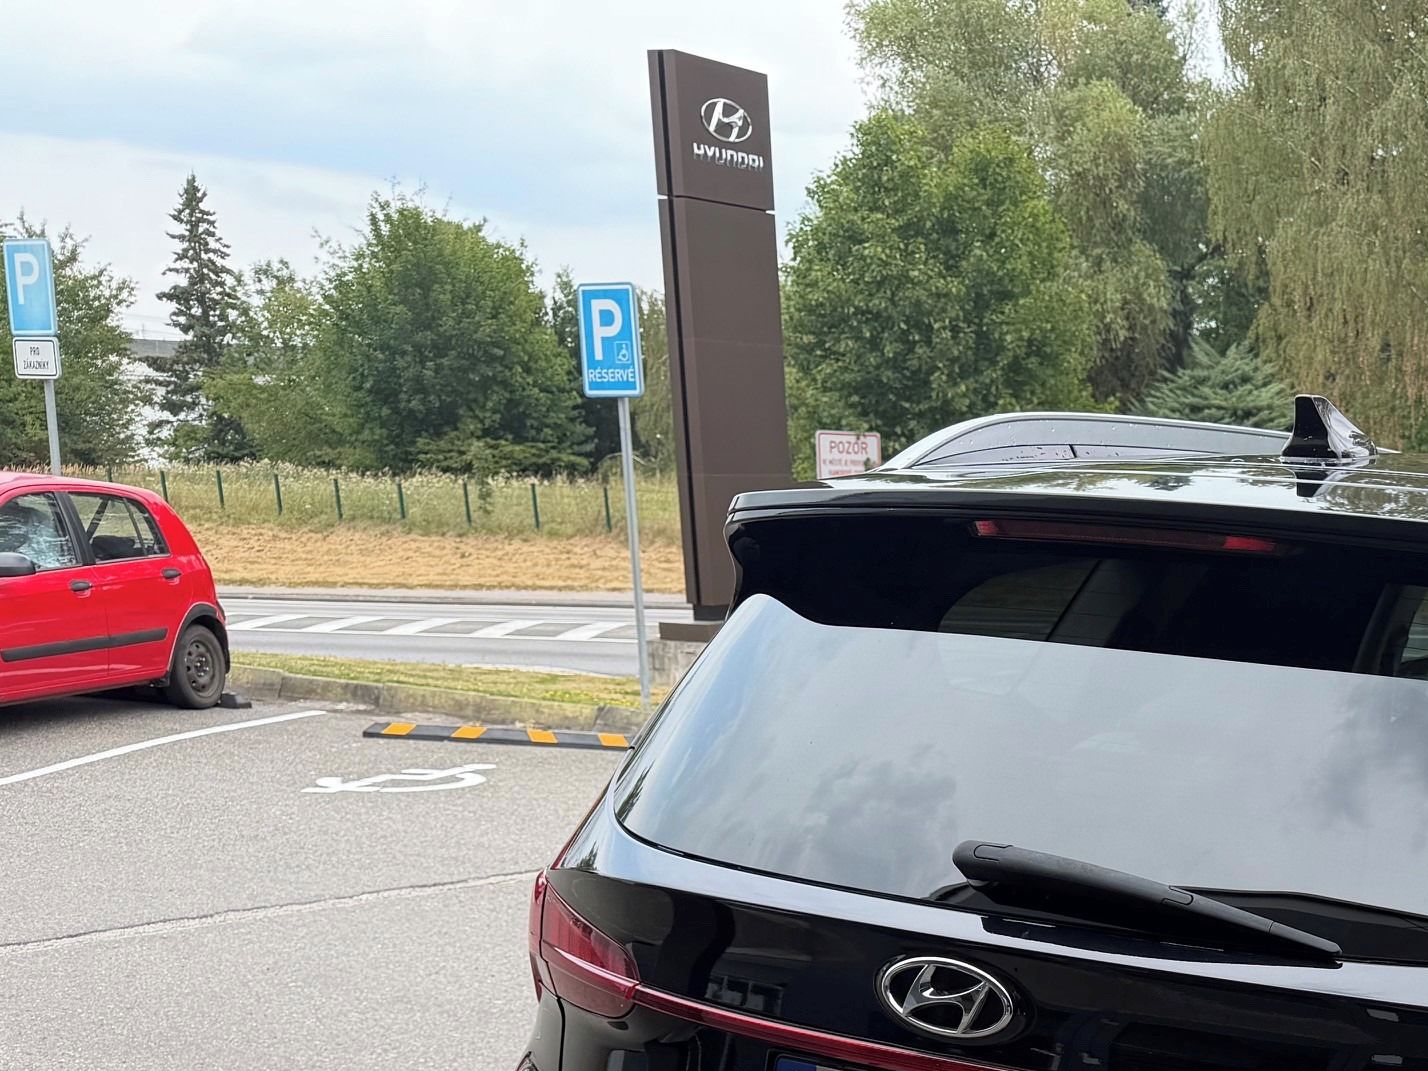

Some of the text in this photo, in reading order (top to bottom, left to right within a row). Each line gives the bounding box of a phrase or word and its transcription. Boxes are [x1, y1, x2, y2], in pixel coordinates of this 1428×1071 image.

[693, 142, 765, 171] HYUNDAI
[14, 253, 40, 305] P
[591, 298, 623, 360] P
[29, 345, 40, 356] PRO
[588, 366, 635, 382] RÉSERVÉ
[829, 440, 869, 455] POZOR
